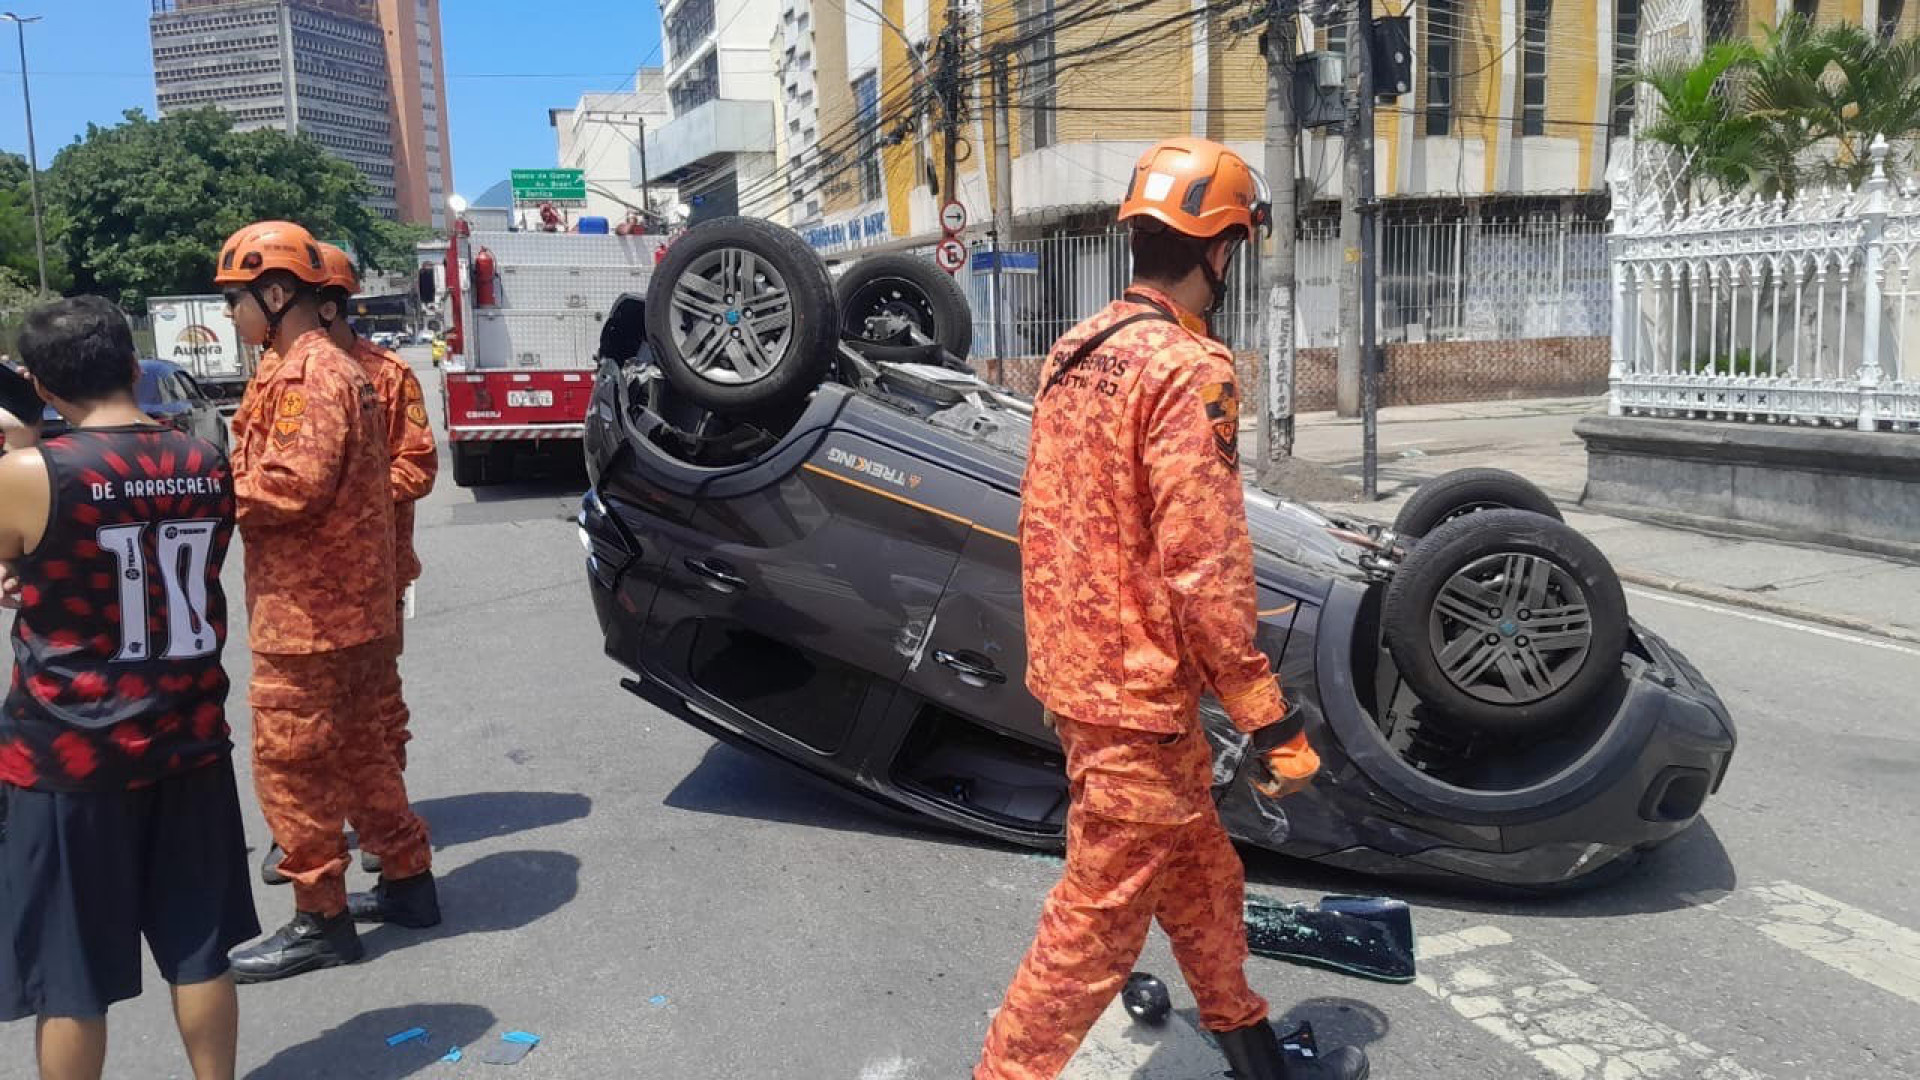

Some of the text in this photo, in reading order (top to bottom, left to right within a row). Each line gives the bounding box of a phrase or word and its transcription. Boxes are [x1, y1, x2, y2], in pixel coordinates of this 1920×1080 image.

[827, 447, 906, 487] TREKKING
[92, 477, 222, 501] DE ARRASCAETA
[96, 518, 222, 662] 10
